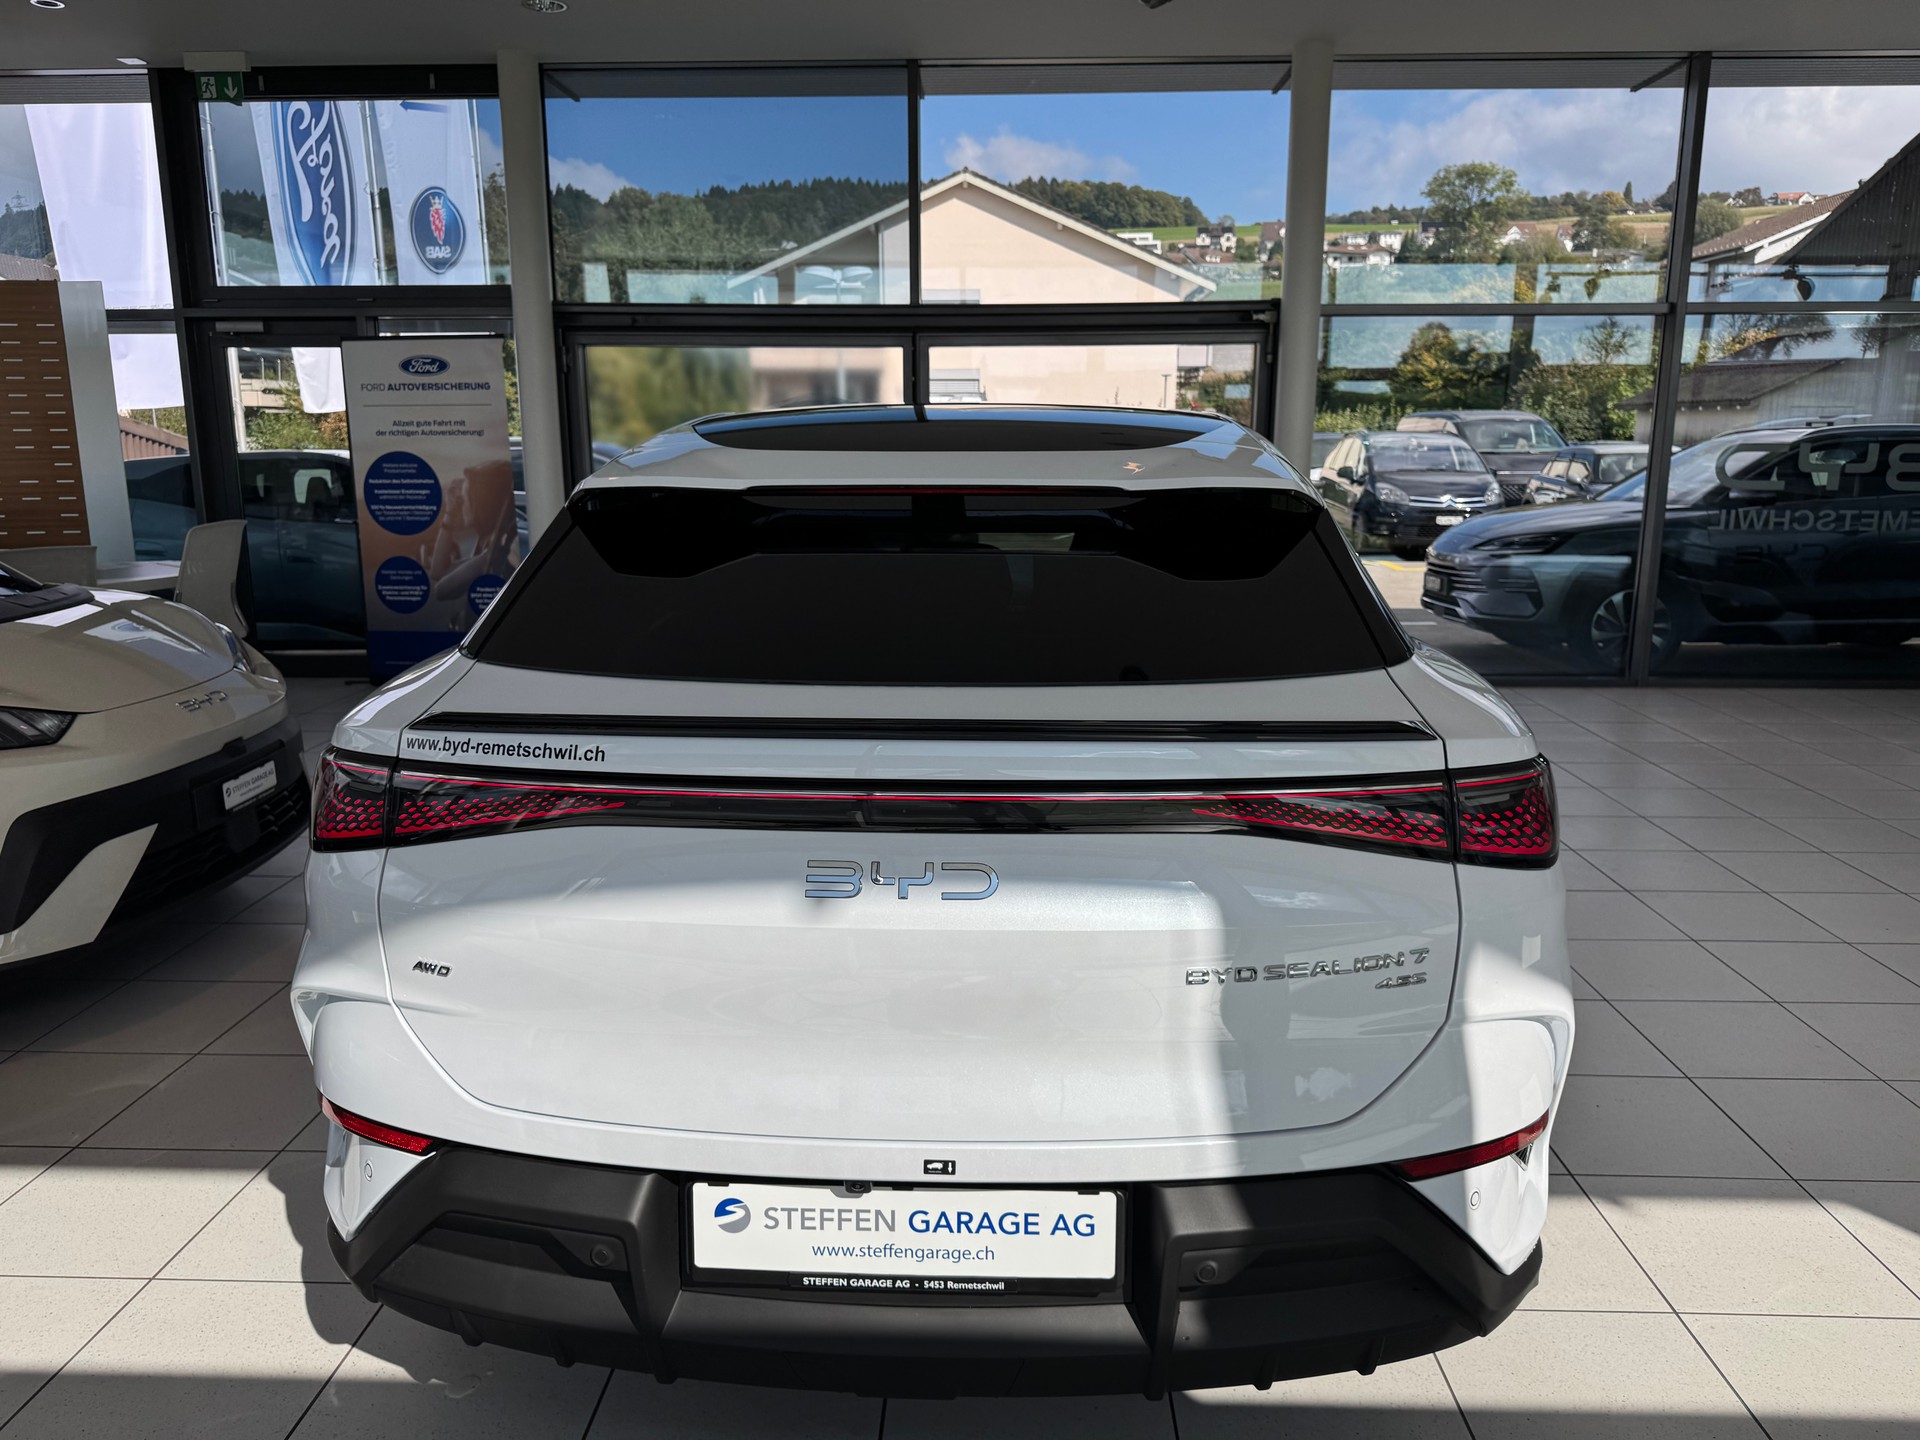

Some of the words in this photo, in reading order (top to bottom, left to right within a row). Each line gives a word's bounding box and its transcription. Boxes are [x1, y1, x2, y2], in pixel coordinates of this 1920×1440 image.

[408, 358, 439, 373] Ford
[360, 383, 386, 392] FORD
[387, 382, 491, 391] AUTOVERSICHERUNG
[375, 429, 387, 437] der
[388, 429, 419, 438] richtigen
[392, 419, 414, 427] Allzeit
[415, 420, 432, 428] gute
[433, 419, 452, 427] Fahrt
[453, 419, 466, 427] mit
[175, 690, 228, 712] BYD
[406, 736, 606, 762] www.byd-remetschwil.ch
[804, 859, 999, 900] BYD
[411, 960, 452, 978] AWD
[1185, 966, 1258, 986] BYD
[1263, 951, 1405, 981] SEALION
[1409, 947, 1430, 965] 7
[763, 1206, 896, 1232] STEFFEN
[908, 1209, 1040, 1236] GARAGE
[1050, 1213, 1096, 1237] AG
[811, 1242, 995, 1264] www.steffengarage.ch
[802, 1276, 848, 1288] STEFFEN
[849, 1277, 893, 1288] GARAGE
[894, 1278, 911, 1289] AG
[923, 1280, 945, 1290] 5453
[946, 1280, 1006, 1291] Remetschwil
